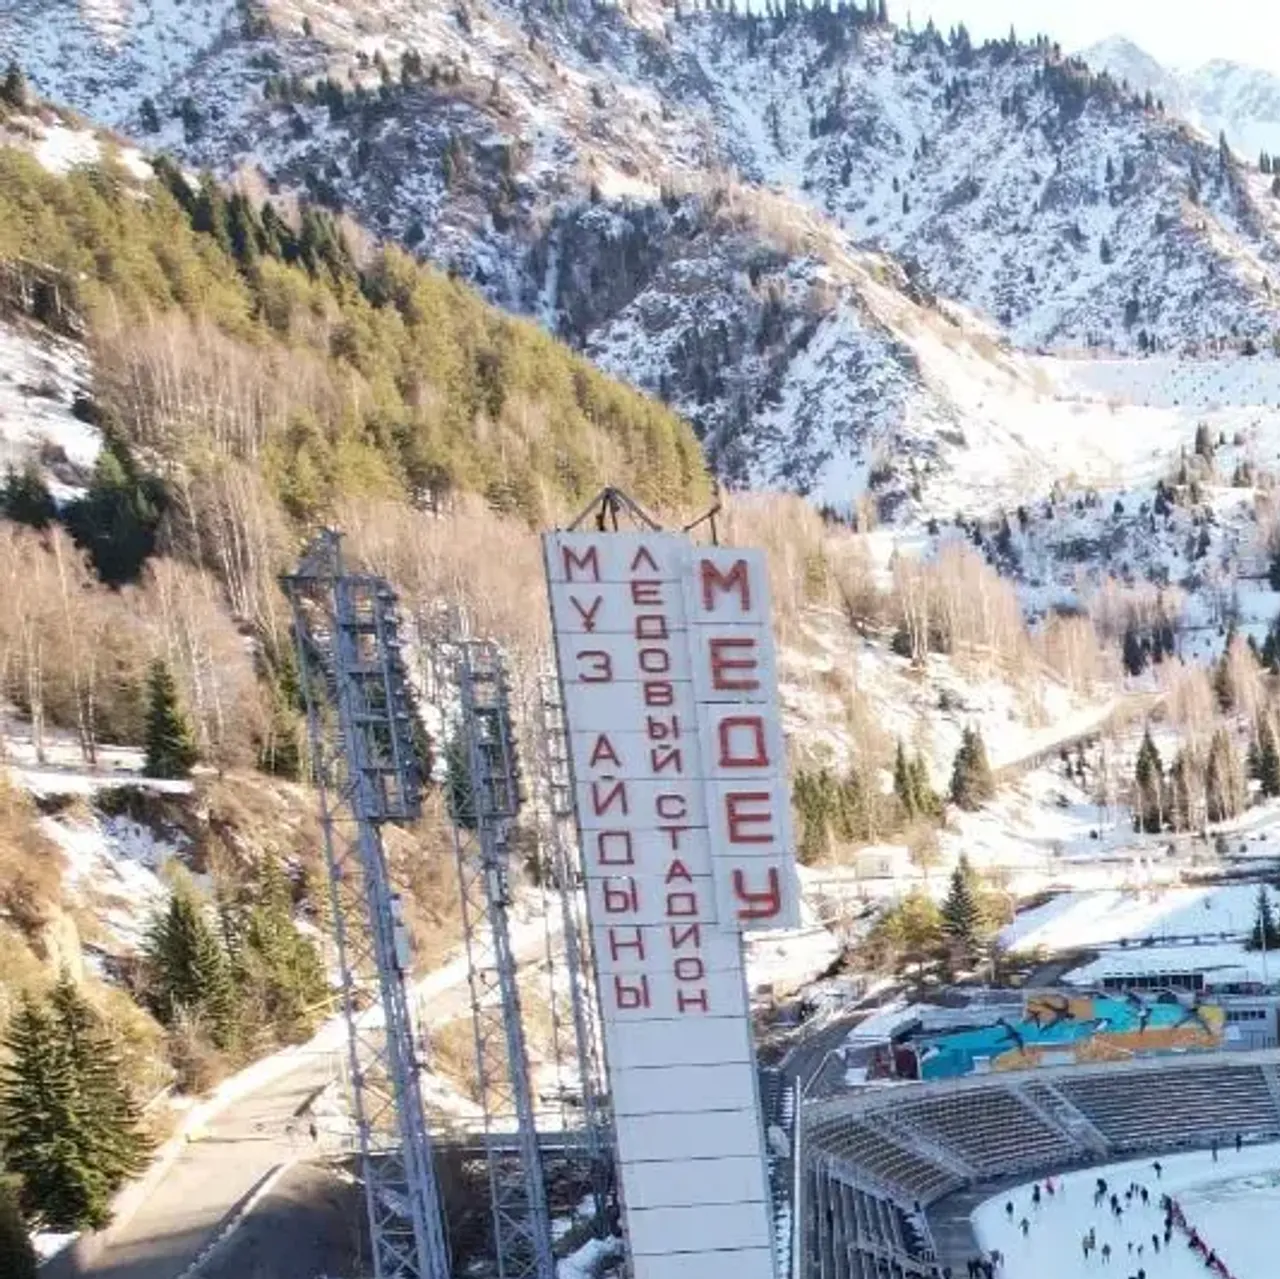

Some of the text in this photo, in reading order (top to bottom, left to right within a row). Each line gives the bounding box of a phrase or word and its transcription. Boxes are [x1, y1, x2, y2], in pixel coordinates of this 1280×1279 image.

[590, 733, 651, 1009] АЙДЫНЫ
[630, 546, 709, 1013] ЛЕДОВЫЙ СТАДИОН
[700, 558, 781, 920] МЕДЕУ
